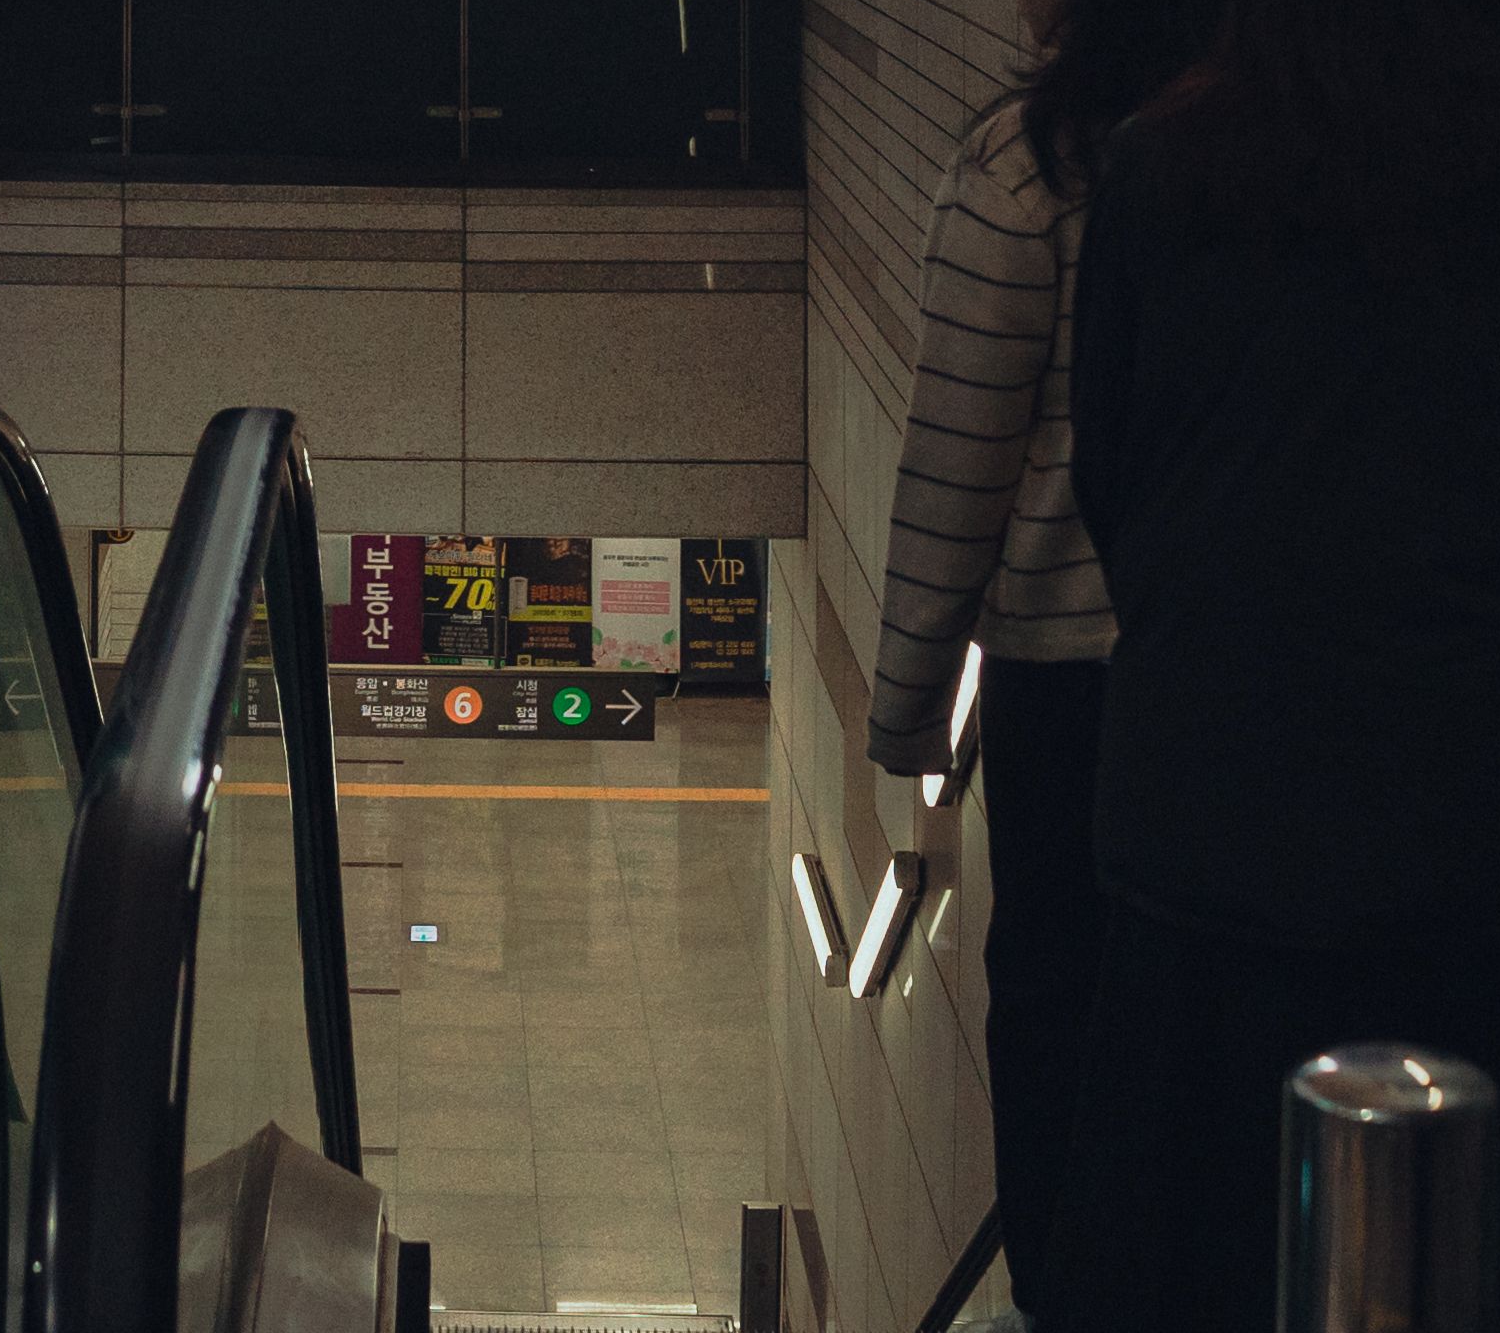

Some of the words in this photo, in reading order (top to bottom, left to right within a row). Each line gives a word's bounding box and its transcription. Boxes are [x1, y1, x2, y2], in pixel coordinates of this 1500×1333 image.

[696, 558, 745, 585] VIP
[356, 678, 378, 690] 응암
[361, 704, 427, 717] 월드컵경기장
[454, 692, 472, 718] 6
[562, 694, 582, 718] 2
